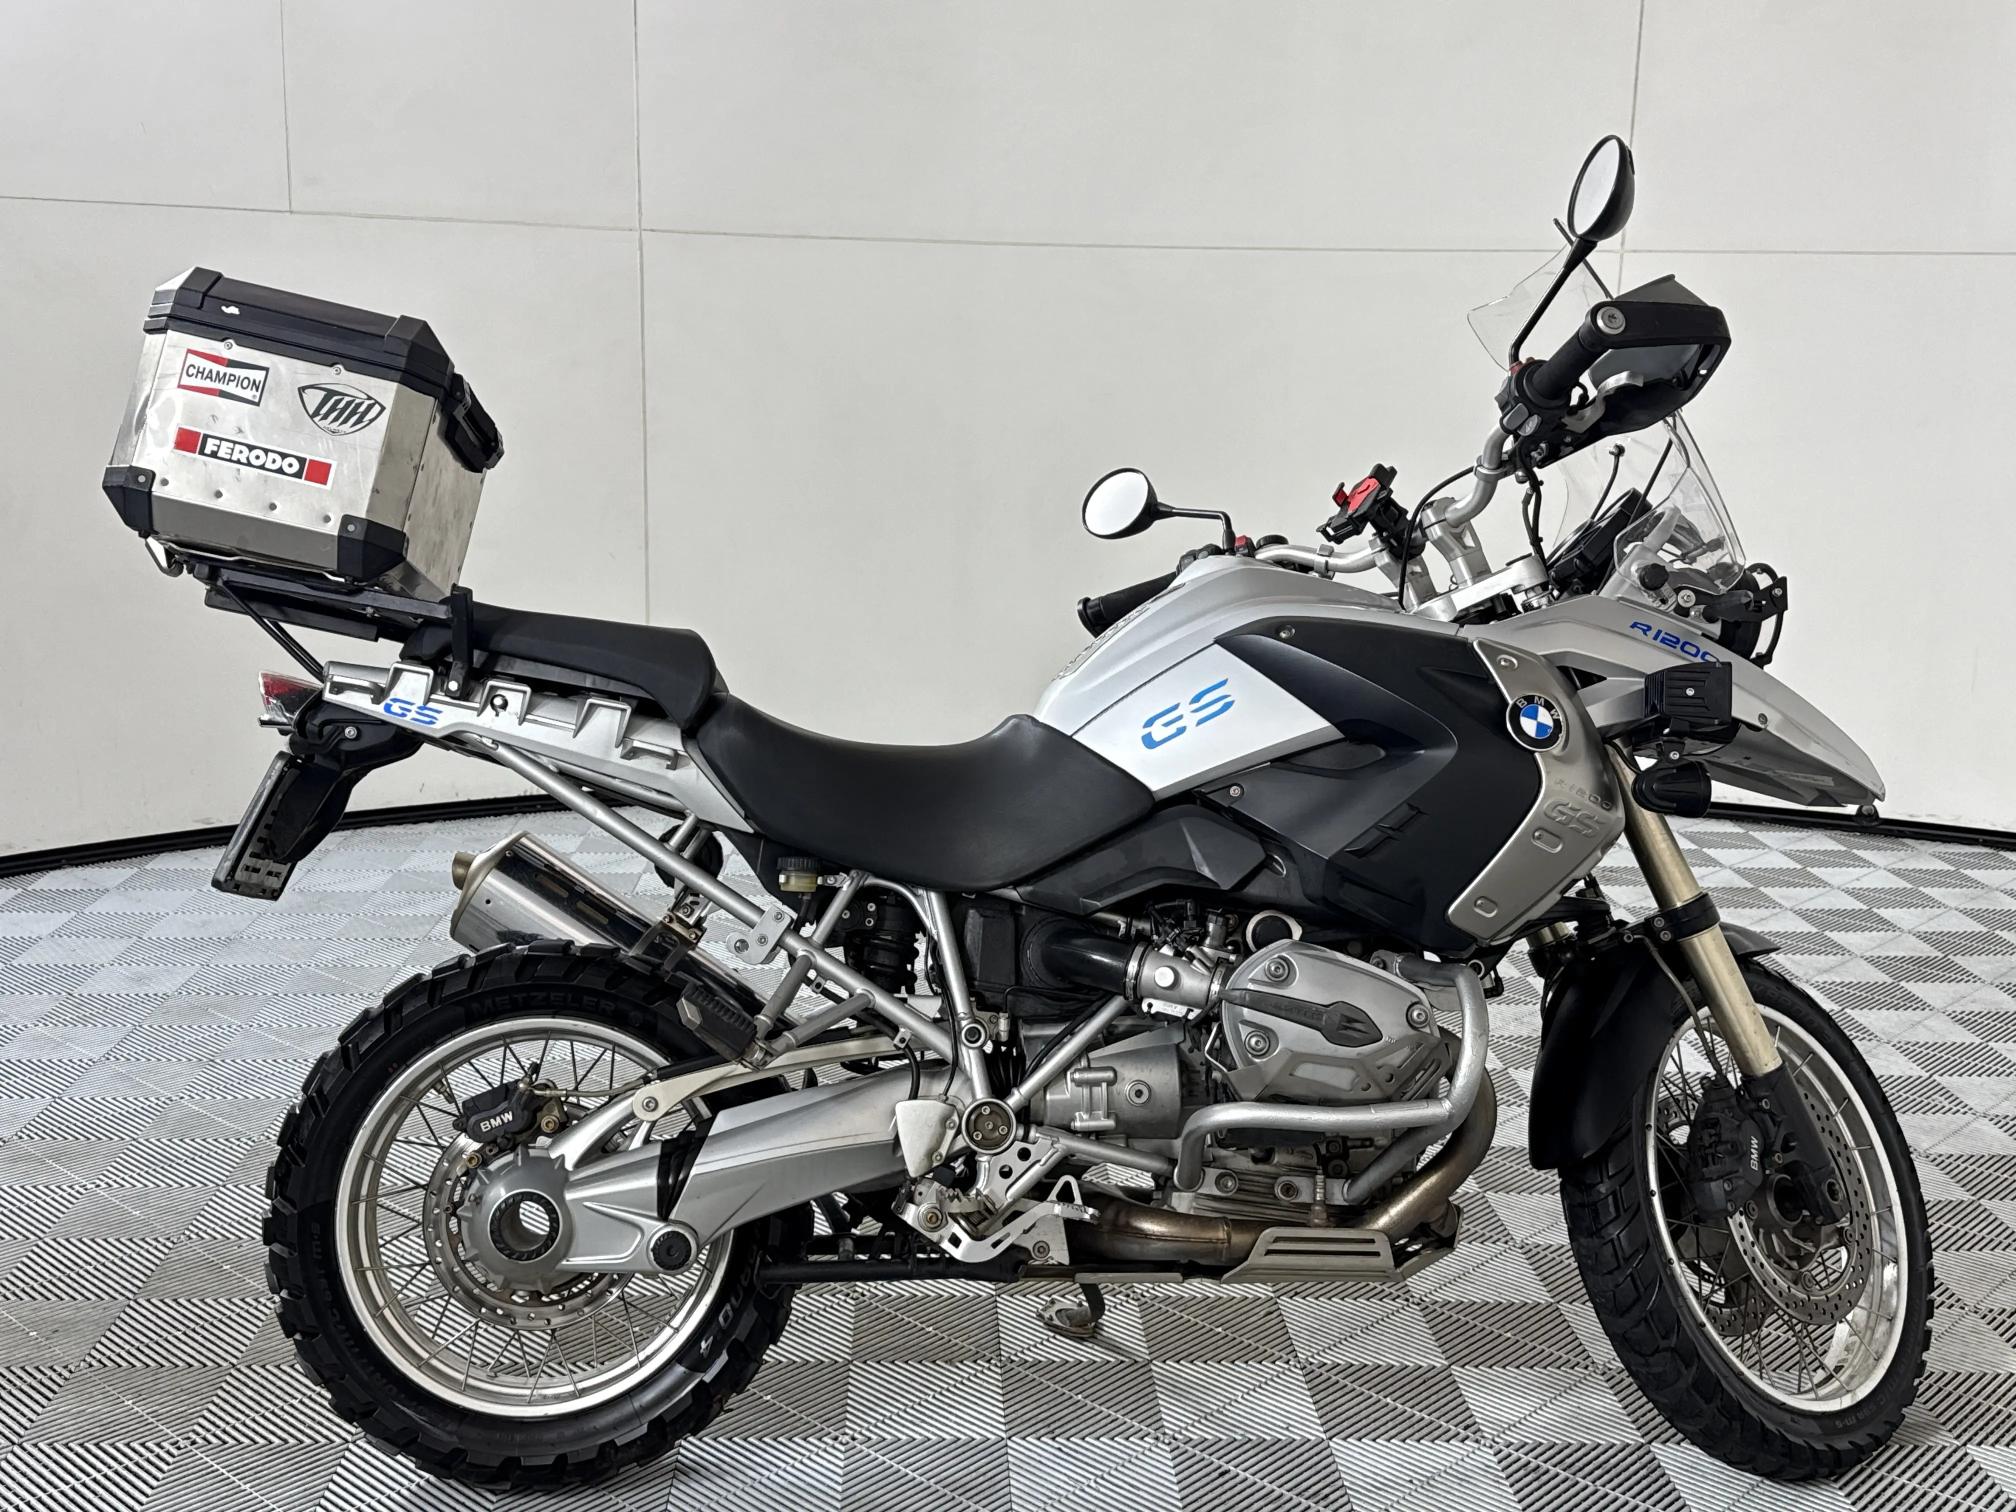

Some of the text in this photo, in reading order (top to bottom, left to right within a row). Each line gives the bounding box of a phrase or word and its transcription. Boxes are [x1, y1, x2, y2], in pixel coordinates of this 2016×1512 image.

[185, 362, 262, 393] CHAMPION
[302, 386, 377, 429] THH
[203, 437, 300, 475] FERODO
[383, 697, 444, 726] GS
[1141, 678, 1236, 750] GS
[1515, 695, 1561, 721] BMW
[471, 991, 617, 1018] METZELER
[479, 1110, 513, 1132] BMW
[1750, 1135, 1759, 1171] BMW
